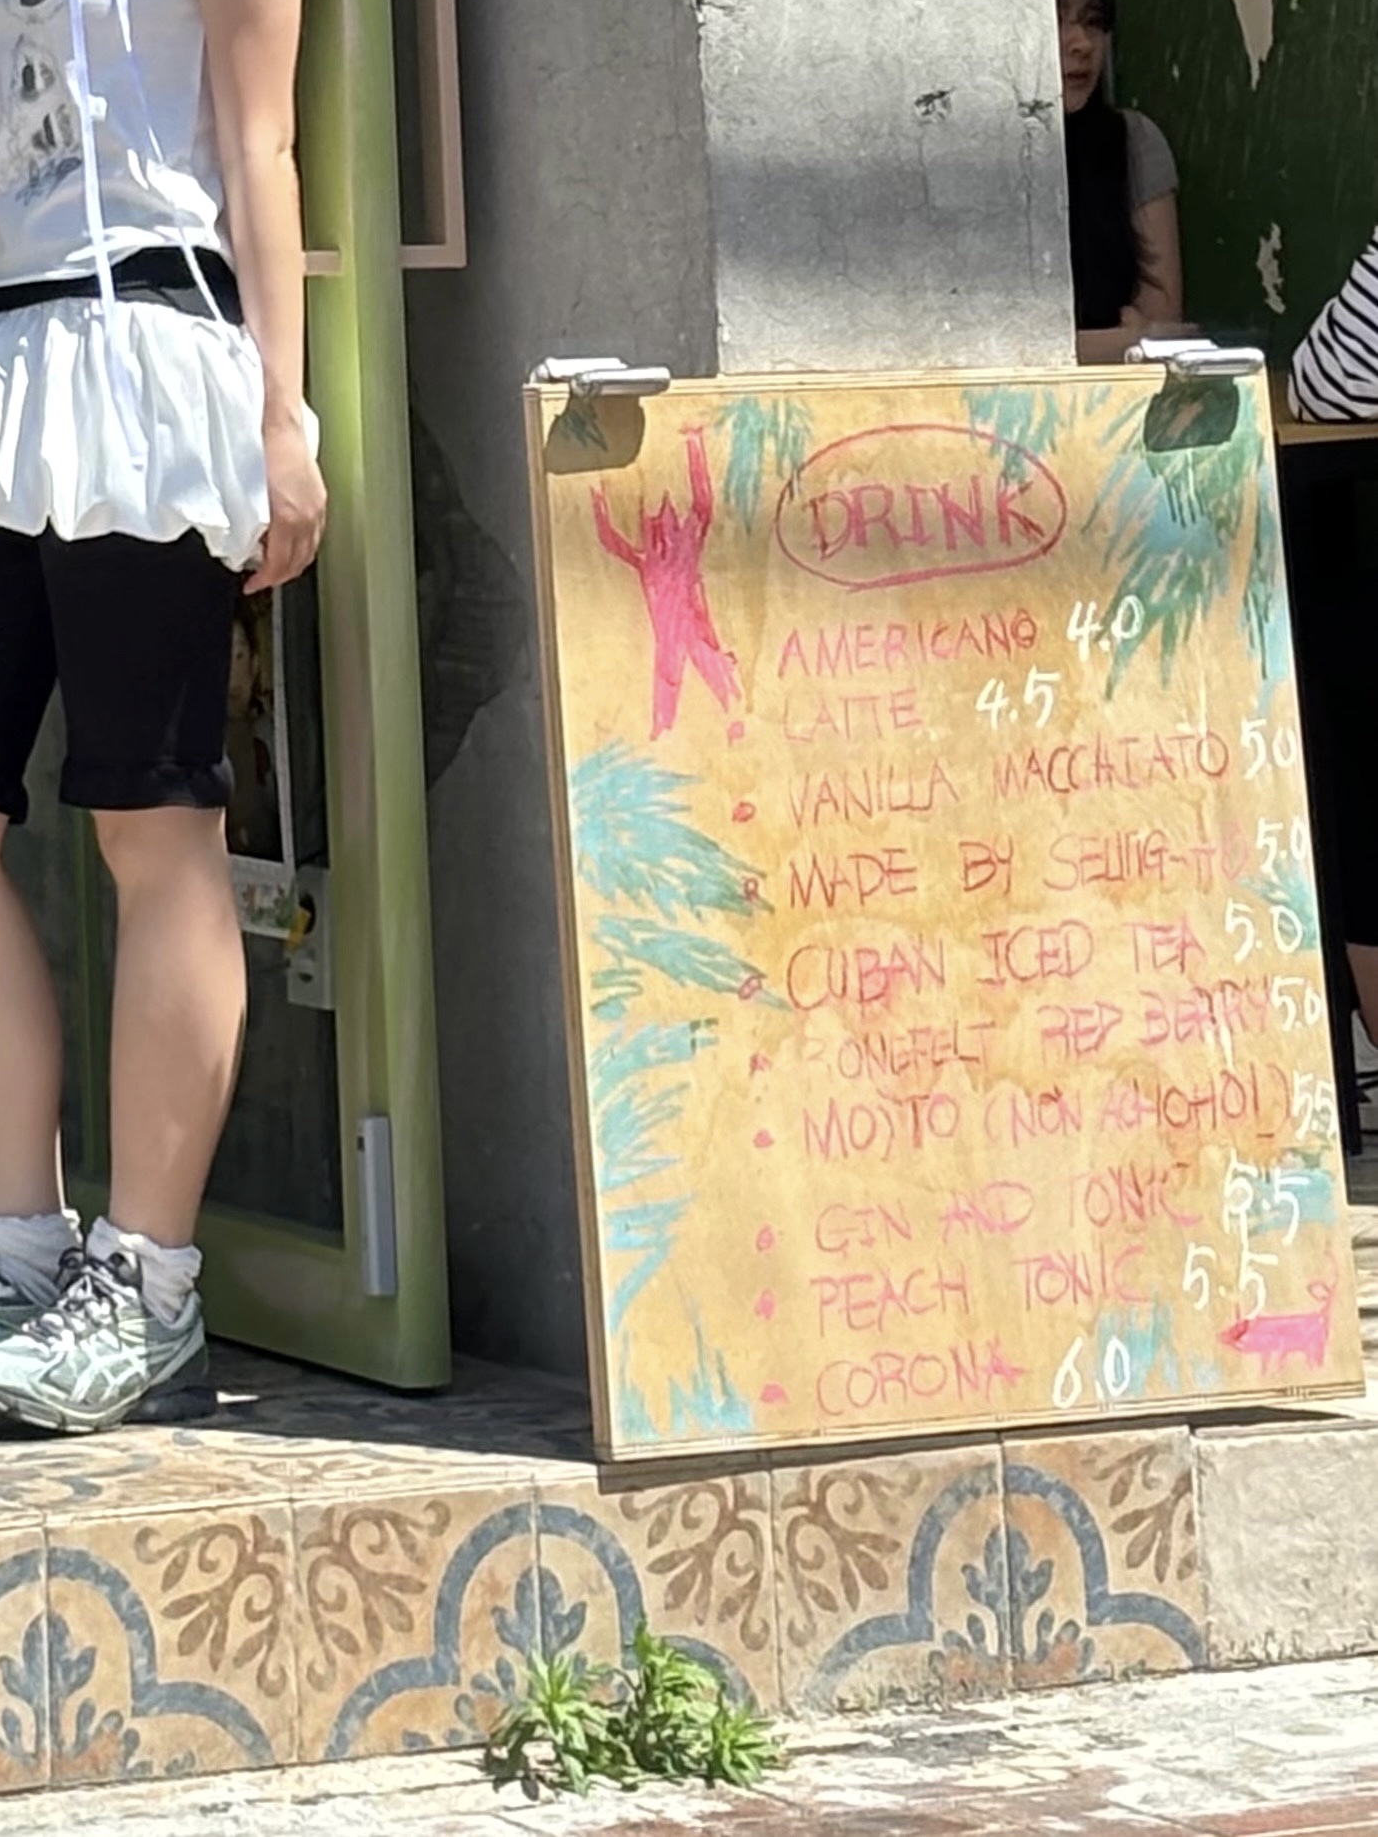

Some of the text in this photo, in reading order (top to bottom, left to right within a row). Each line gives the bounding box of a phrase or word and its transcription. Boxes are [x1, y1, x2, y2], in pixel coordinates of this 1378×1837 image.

[803, 474, 1045, 561] DRINK
[778, 594, 1144, 679] AMERICANO 4.0
[782, 665, 1062, 743] LATTE 4.5
[789, 758, 960, 830] VANILLA
[993, 731, 1230, 800] MACCHIATO
[789, 848, 919, 911] MADE
[959, 835, 1014, 896] BY
[1256, 817, 1308, 874] 5.0
[787, 898, 1303, 1012] CUBAN ICED TEA 5.0
[1036, 1003, 1124, 1059] RED
[1272, 976, 1322, 1032] 5.0
[816, 1202, 913, 1255] GIN
[939, 1180, 1034, 1243] AND
[1067, 1161, 1203, 1229] TONIC
[810, 1242, 1279, 1337] PEACH TONIC 5.5
[817, 1336, 1131, 1417] CORONA 6.0
